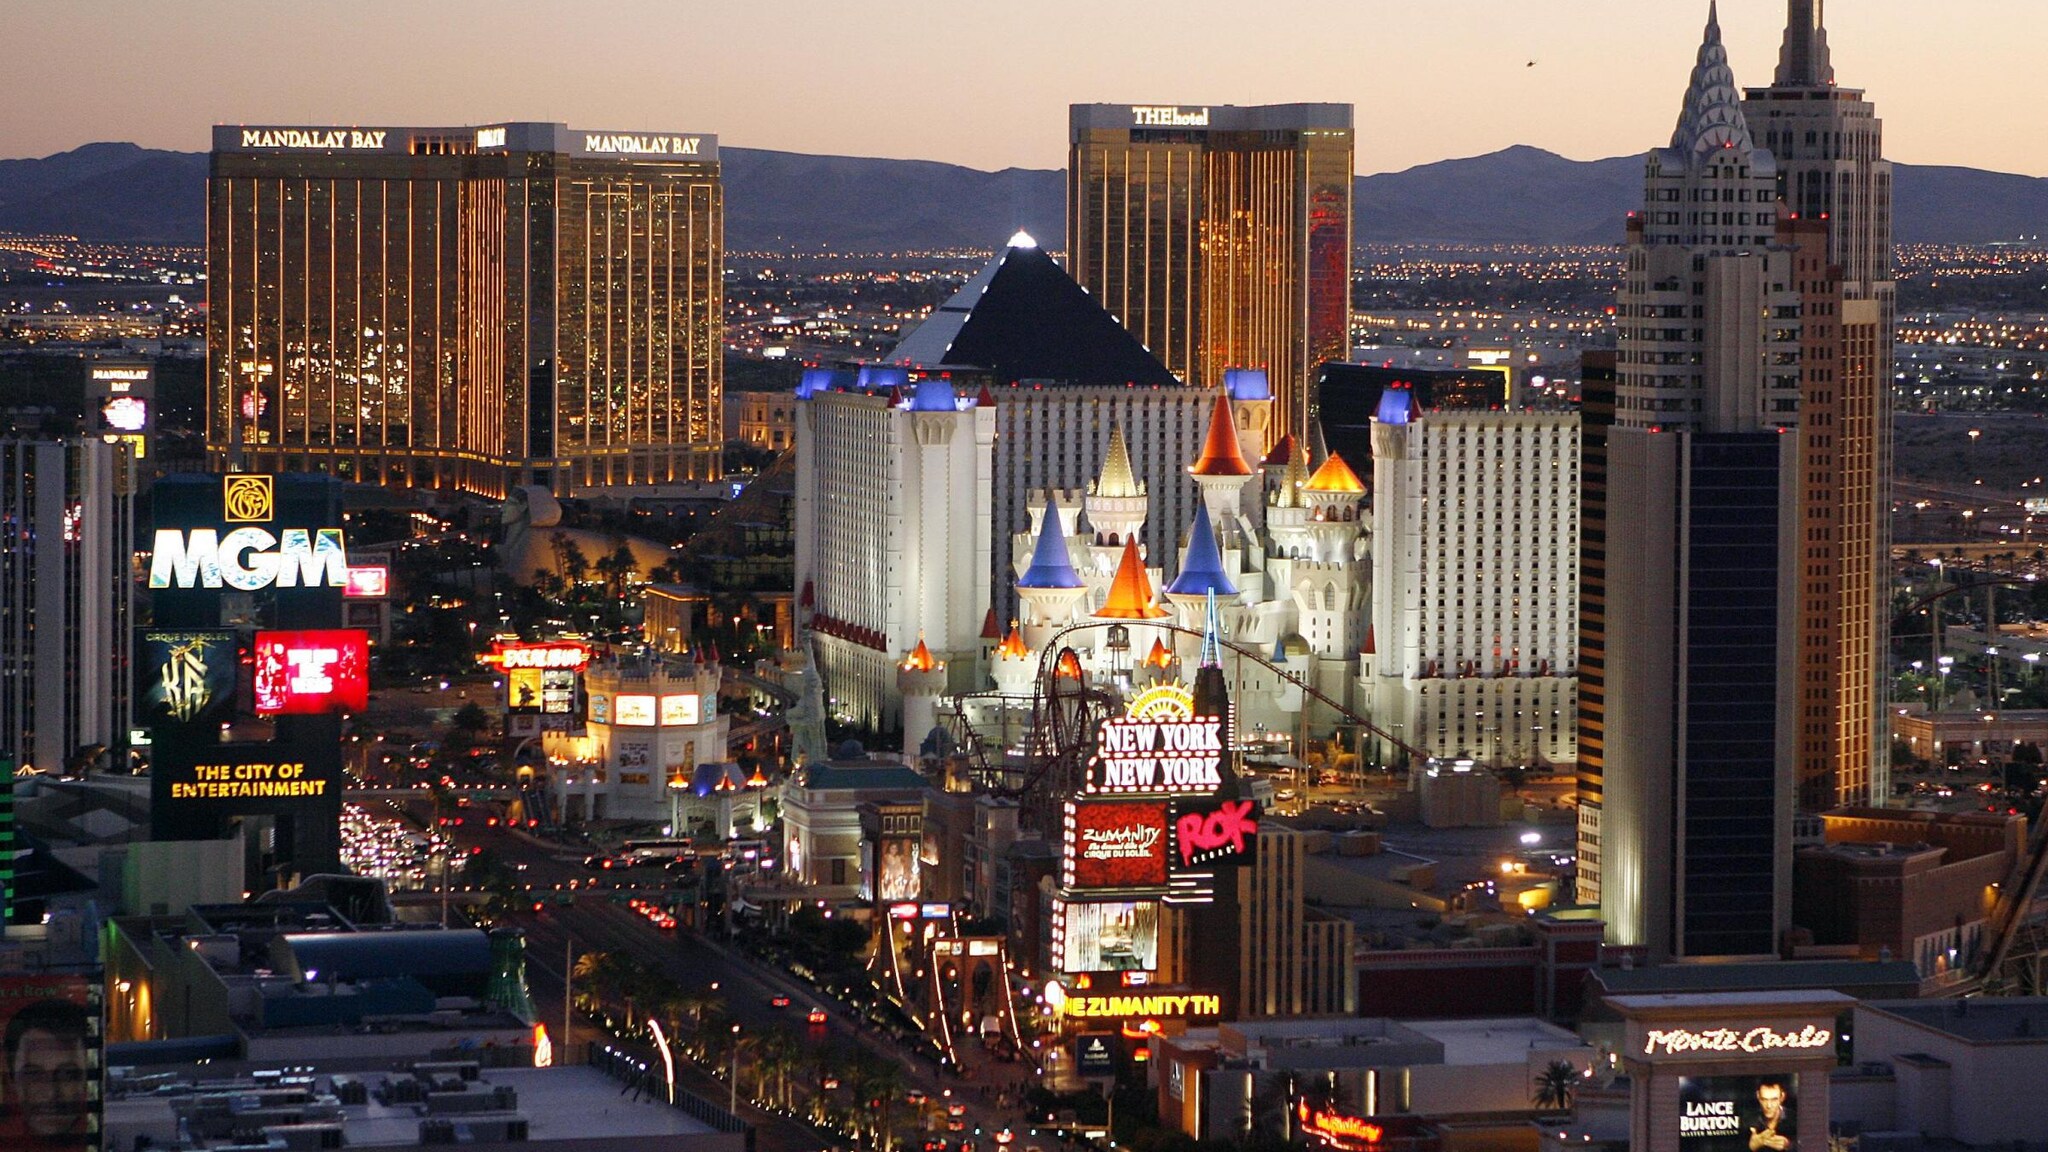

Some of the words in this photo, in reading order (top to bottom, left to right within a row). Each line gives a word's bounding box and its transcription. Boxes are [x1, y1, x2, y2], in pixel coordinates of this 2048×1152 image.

[1131, 106, 1209, 126] THEhotel
[242, 130, 347, 149] MANDALAY
[351, 131, 386, 149] BAY
[585, 135, 669, 154] MANDALAY
[672, 137, 701, 154] BAY
[93, 369, 149, 380] MANDALAY
[111, 382, 131, 392] BAY
[149, 527, 347, 590] MGM
[145, 632, 181, 643] CIRQUE
[183, 633, 196, 641] DU
[199, 632, 231, 641] SOLEIL
[503, 648, 583, 668] EXCALIBUR
[1105, 723, 1157, 752] NEW
[1159, 722, 1222, 752] YORK
[195, 765, 231, 780] THE
[234, 764, 274, 780] CITY
[278, 763, 304, 779] OF
[1104, 758, 1157, 786] NEW
[1159, 757, 1222, 786] YORK
[171, 780, 326, 798] ENTERTAINMENT
[1083, 823, 1161, 848] ZUMANITY
[1176, 800, 1257, 867] ROK
[1084, 850, 1112, 860] CIRQUE
[1113, 849, 1124, 858] DU
[1086, 996, 1190, 1016] ZUMANITY
[1190, 995, 1220, 1015] TH
[1644, 1027, 1738, 1055] Monte
[1739, 1024, 1831, 1053] Carlo
[1686, 1101, 1734, 1116] LANCE
[1680, 1115, 1740, 1131] BURTON
